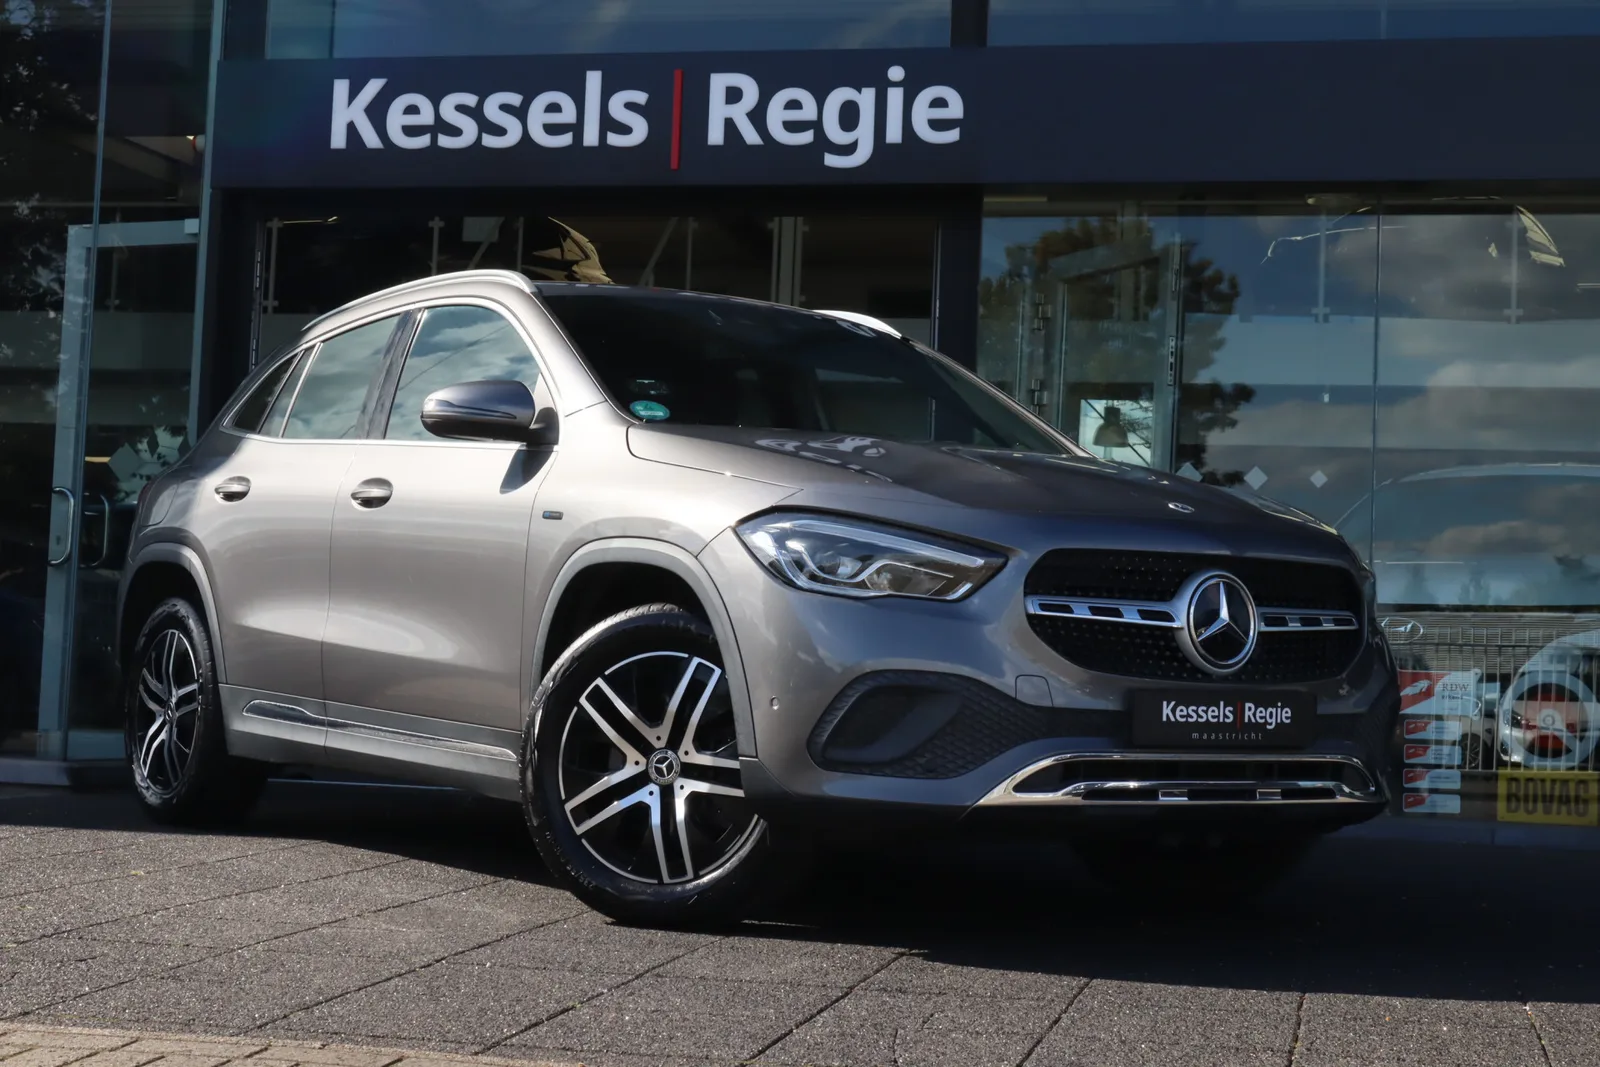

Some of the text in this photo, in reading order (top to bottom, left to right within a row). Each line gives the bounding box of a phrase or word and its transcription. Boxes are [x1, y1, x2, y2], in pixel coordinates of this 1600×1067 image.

[329, 65, 965, 168] Kessels Regie
[1441, 683, 1470, 693] RDW
[1162, 701, 1292, 729] Kessels Regie
[1192, 732, 1263, 741] maastricht
[1506, 777, 1590, 817] BOVAG
